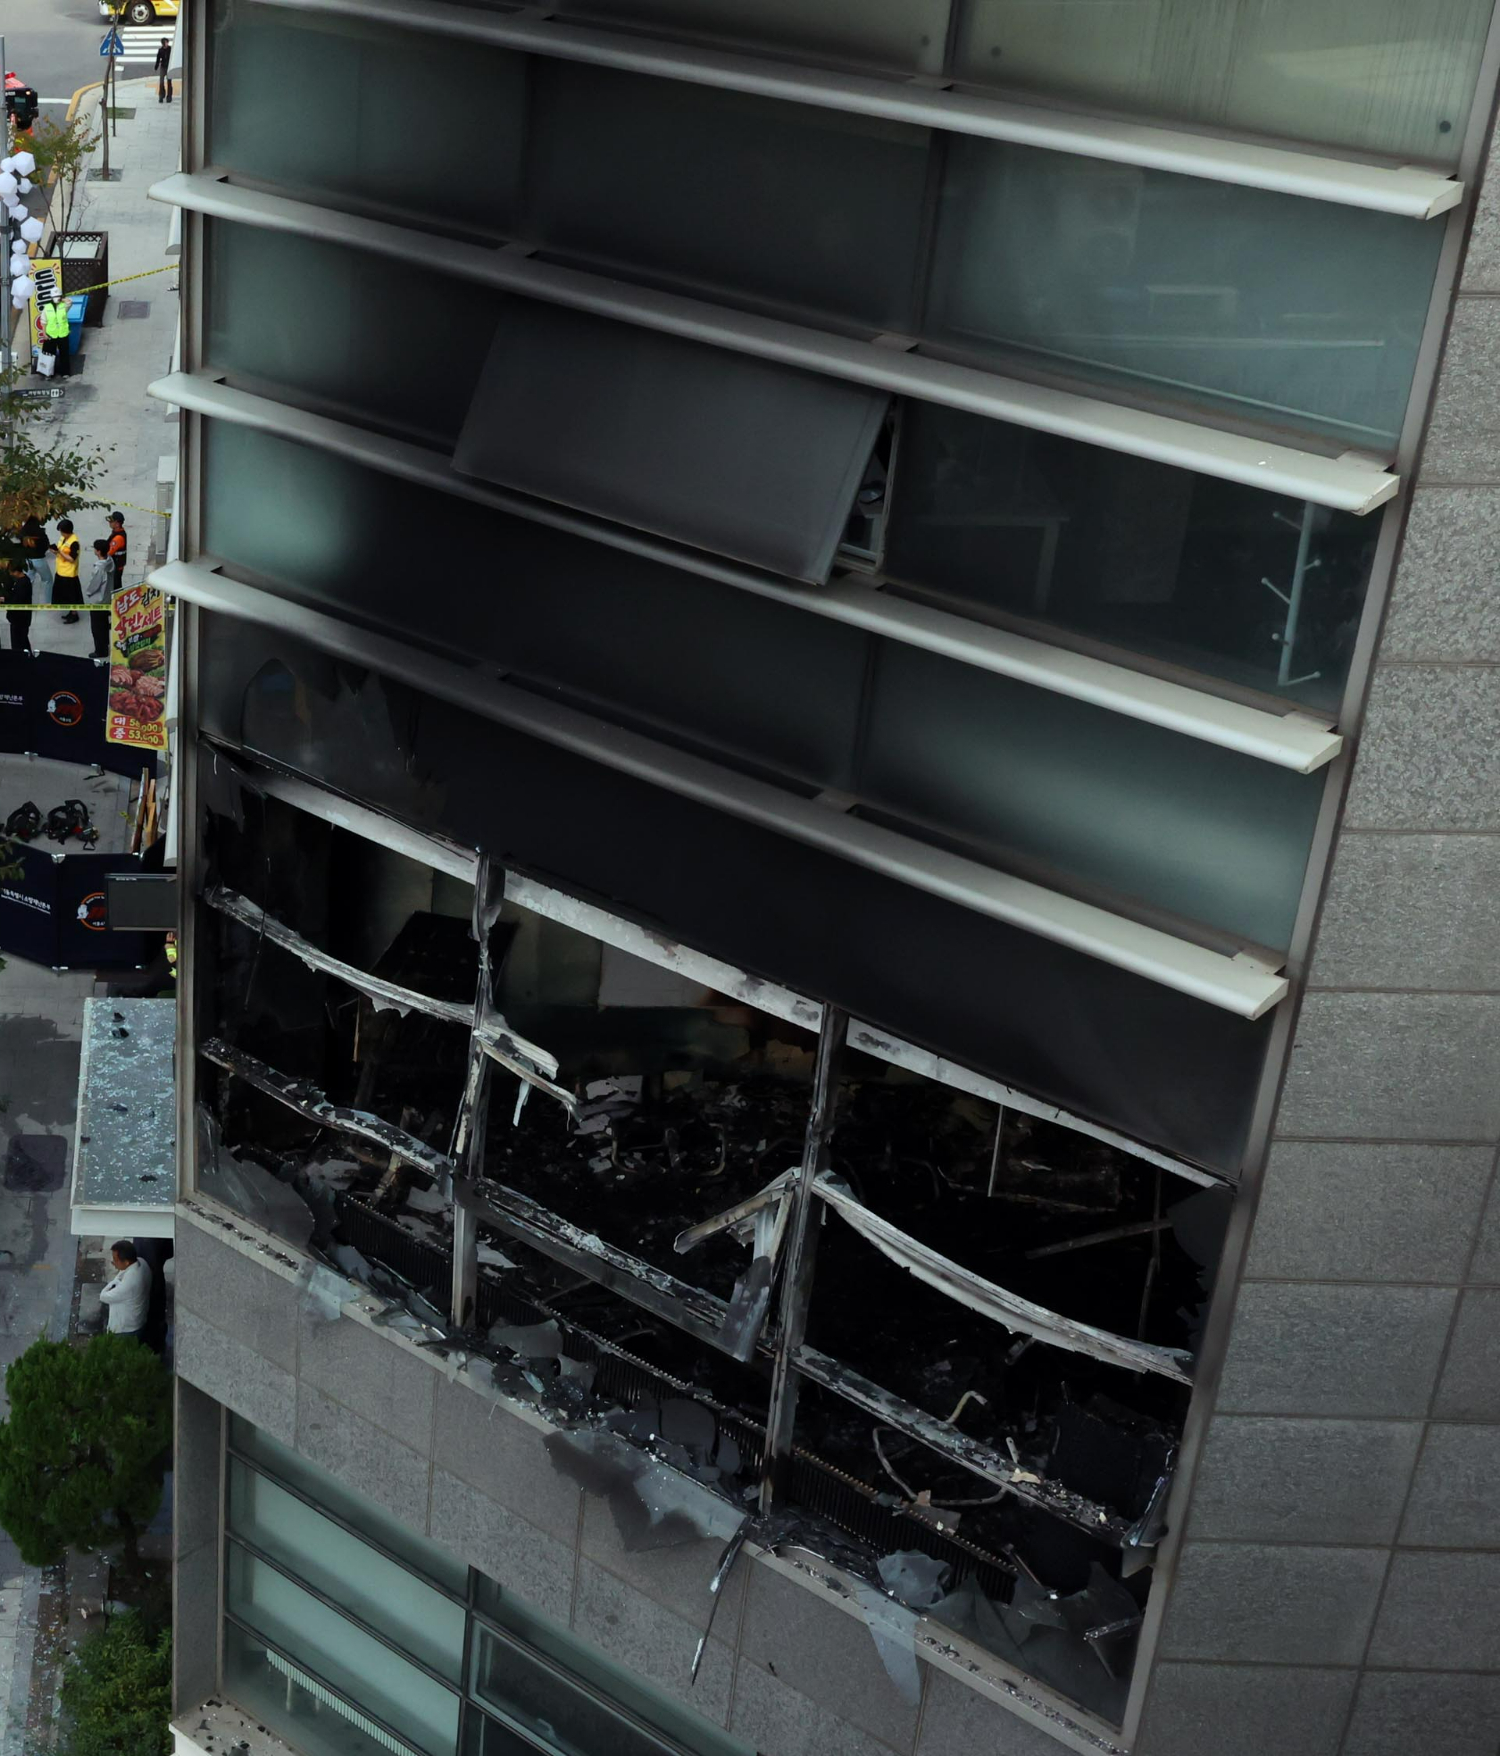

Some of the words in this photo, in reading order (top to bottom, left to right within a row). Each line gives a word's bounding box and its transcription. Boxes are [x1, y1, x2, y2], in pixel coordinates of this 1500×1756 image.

[116, 588, 142, 615] 남도
[114, 717, 126, 726] 대
[113, 728, 126, 739] 중
